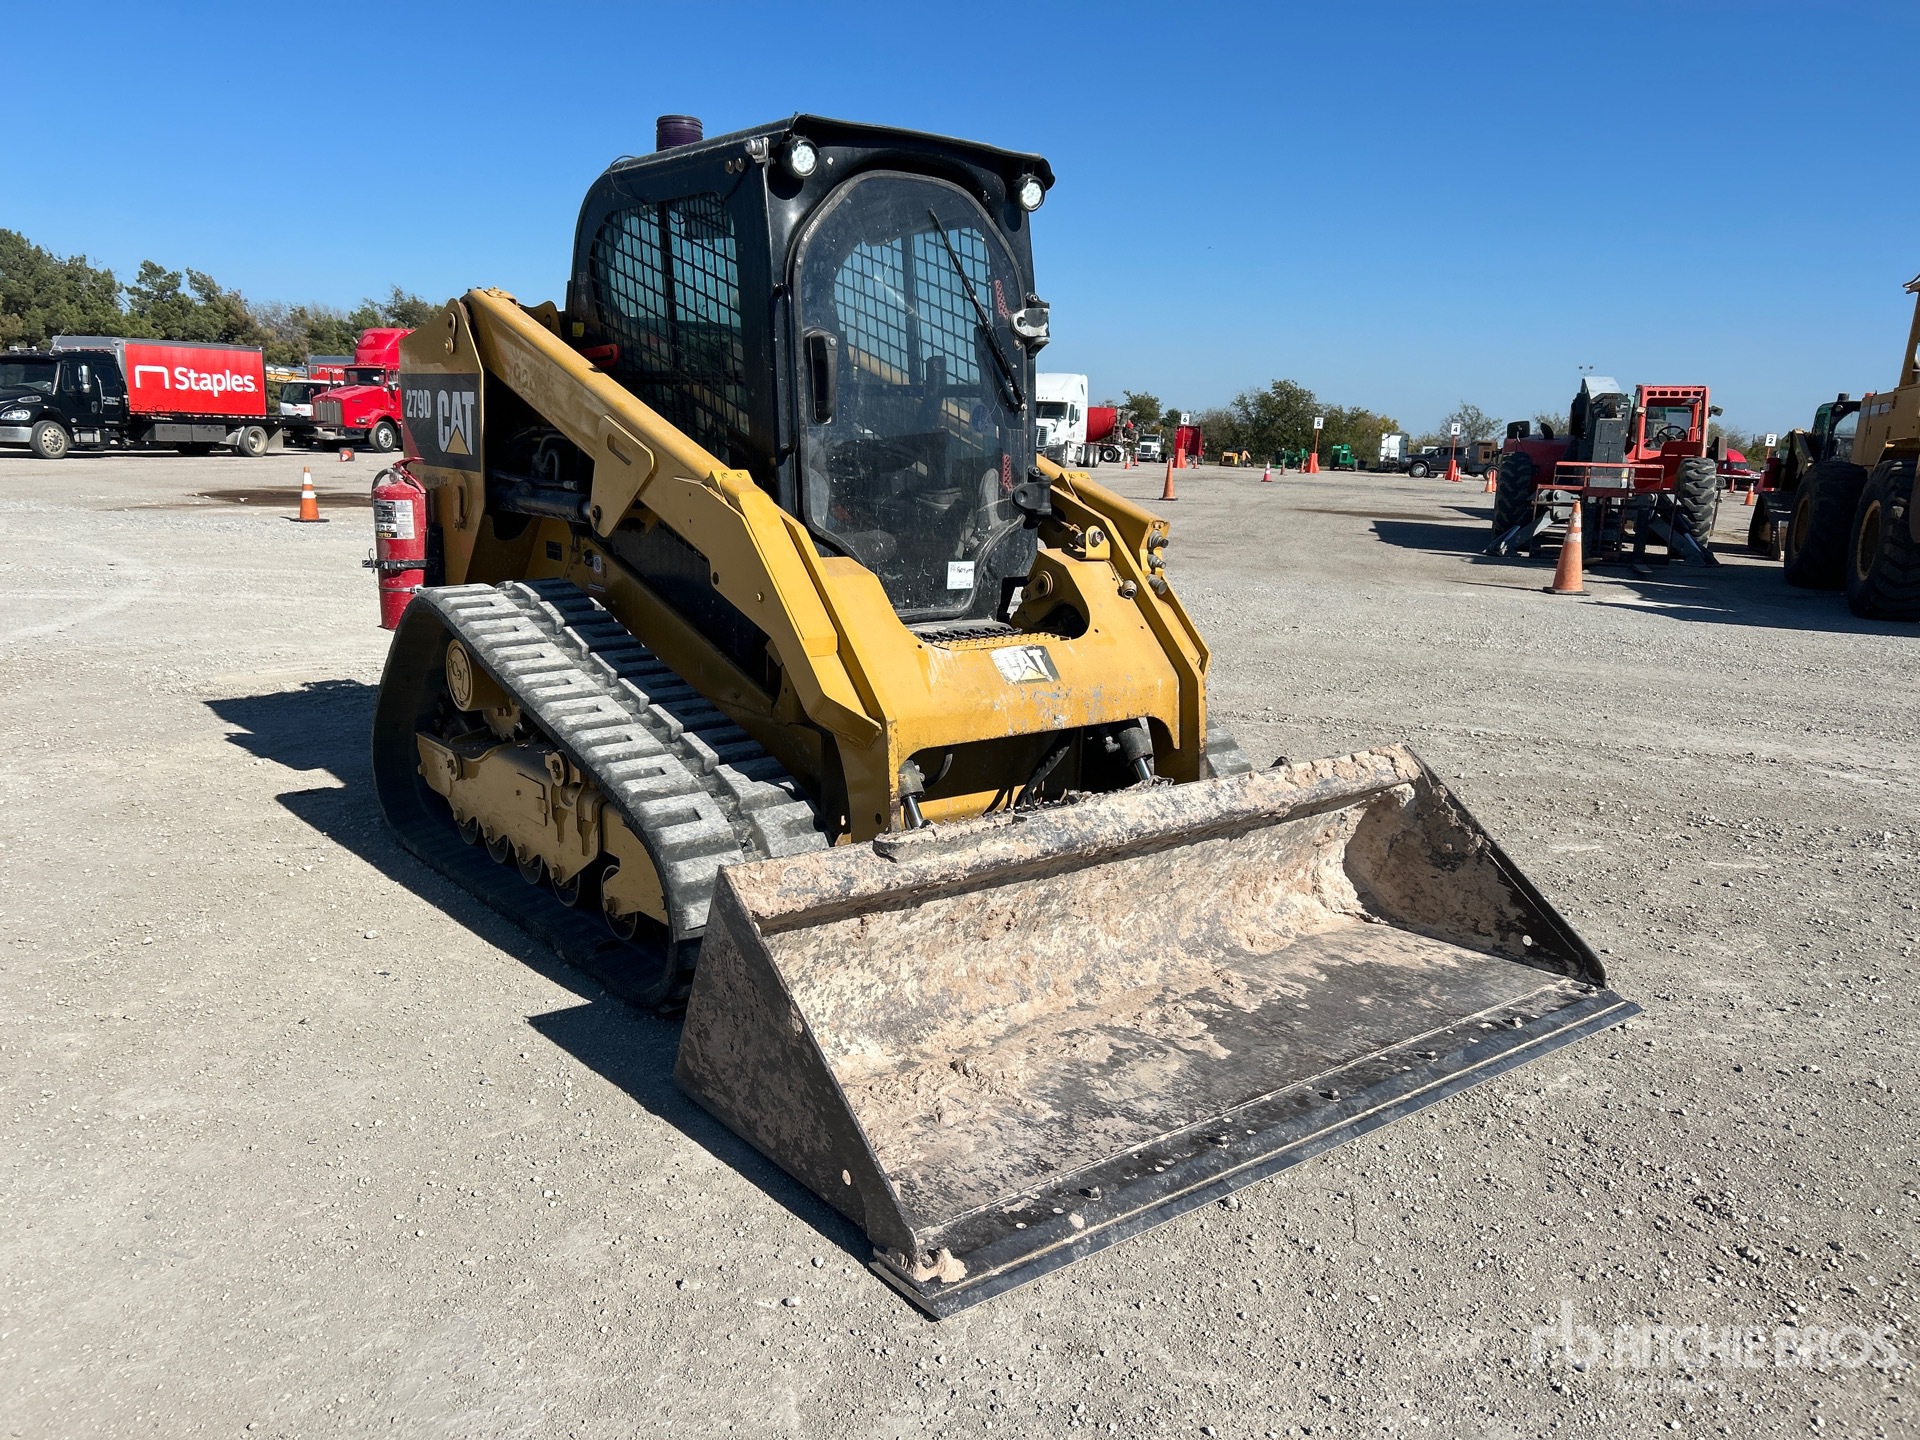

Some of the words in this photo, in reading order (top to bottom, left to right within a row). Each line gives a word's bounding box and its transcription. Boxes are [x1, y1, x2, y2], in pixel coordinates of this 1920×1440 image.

[174, 366, 256, 397] Staples
[405, 389, 432, 419] 279D
[437, 389, 475, 456] CAT
